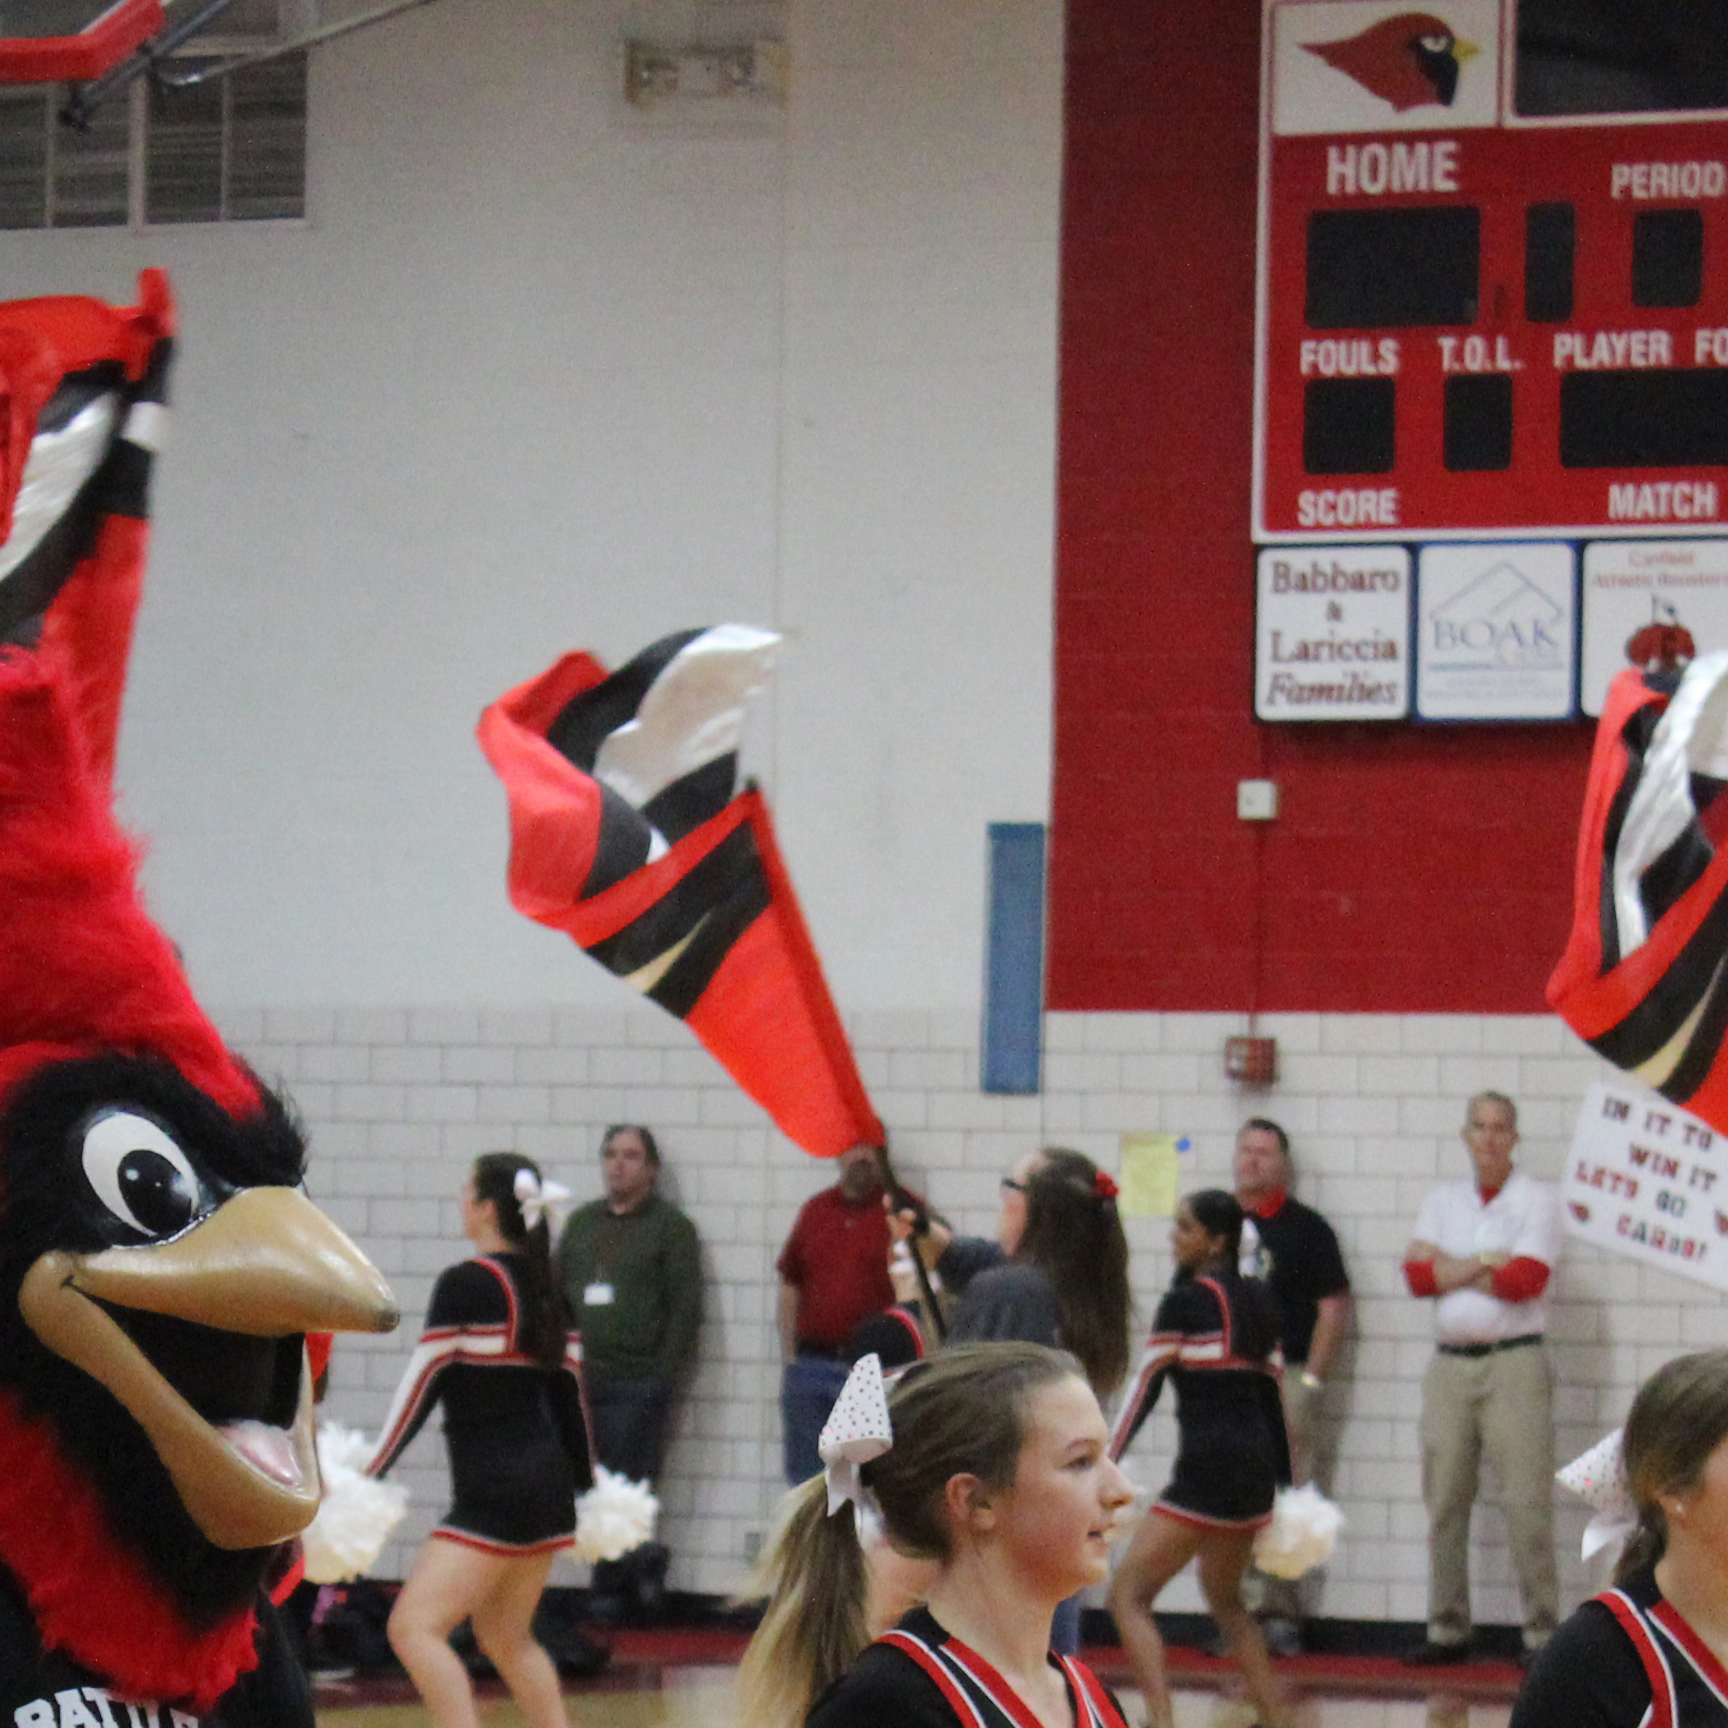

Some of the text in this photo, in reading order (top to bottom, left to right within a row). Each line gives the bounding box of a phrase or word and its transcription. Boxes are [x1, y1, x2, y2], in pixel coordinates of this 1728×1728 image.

[1326, 142, 1460, 195] HOME
[1611, 162, 1728, 199] PERIOD
[1300, 338, 1400, 375] FOULS
[1438, 335, 1523, 373] T.O.L.
[1553, 330, 1673, 369] PLAYER
[1298, 489, 1400, 527] SCORE
[1608, 482, 1718, 520] MATCH
[1271, 560, 1401, 595] Babbaro
[1270, 630, 1398, 664] Lariccia
[1432, 618, 1559, 651] BOAK
[1266, 671, 1397, 706] Families
[1602, 1096, 1714, 1152] IN IT TO
[1628, 1143, 1717, 1193] WIN IT
[1655, 1188, 1689, 1219] GO
[1615, 1213, 1708, 1258] CARDS!
